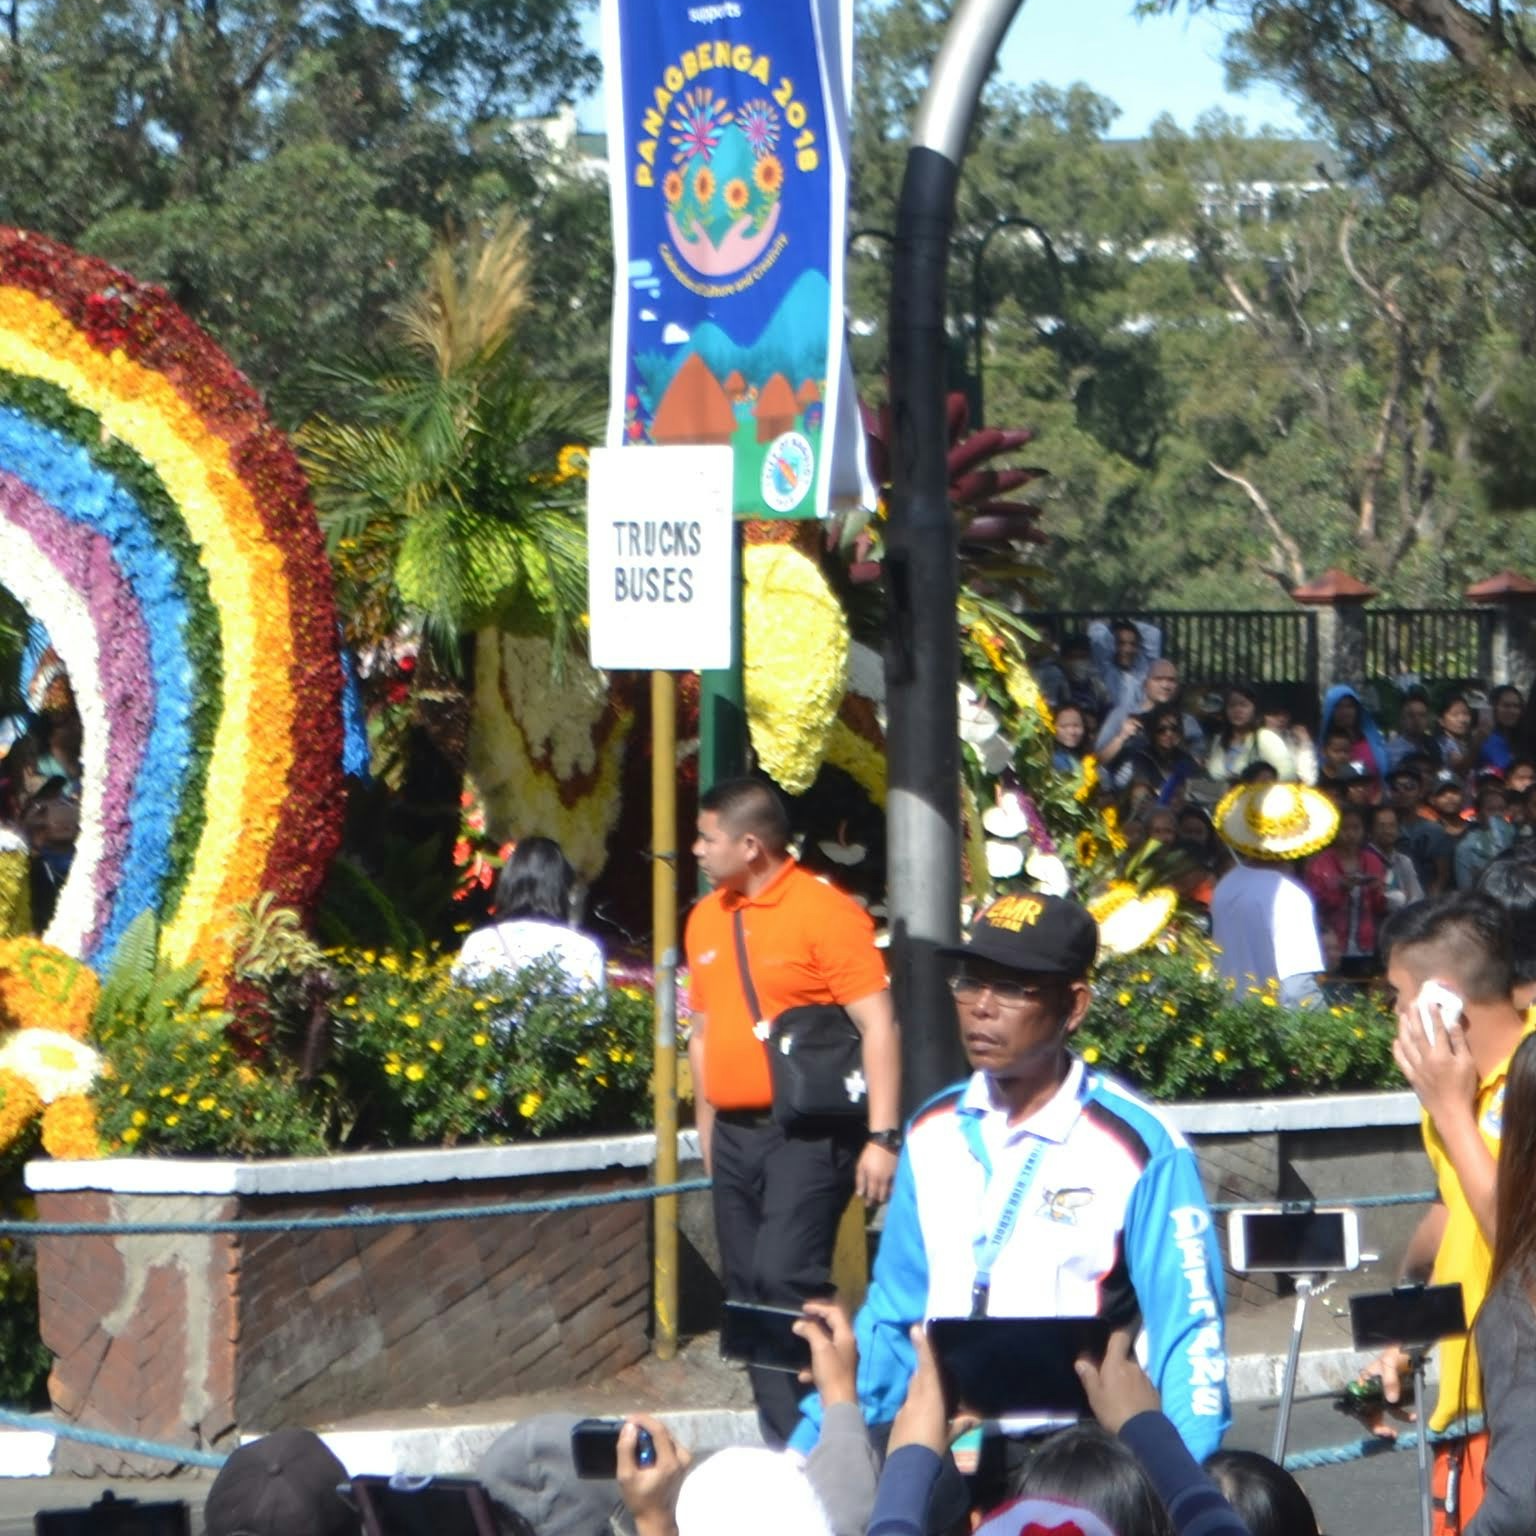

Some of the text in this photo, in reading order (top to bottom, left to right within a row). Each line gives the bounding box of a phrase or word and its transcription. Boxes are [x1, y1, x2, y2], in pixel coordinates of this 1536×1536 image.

[635, 40, 770, 187] PANAGBENGA
[612, 521, 701, 556] TRUCKS
[614, 566, 694, 603] BUSES
[1008, 1180, 1026, 1207] HIGH
